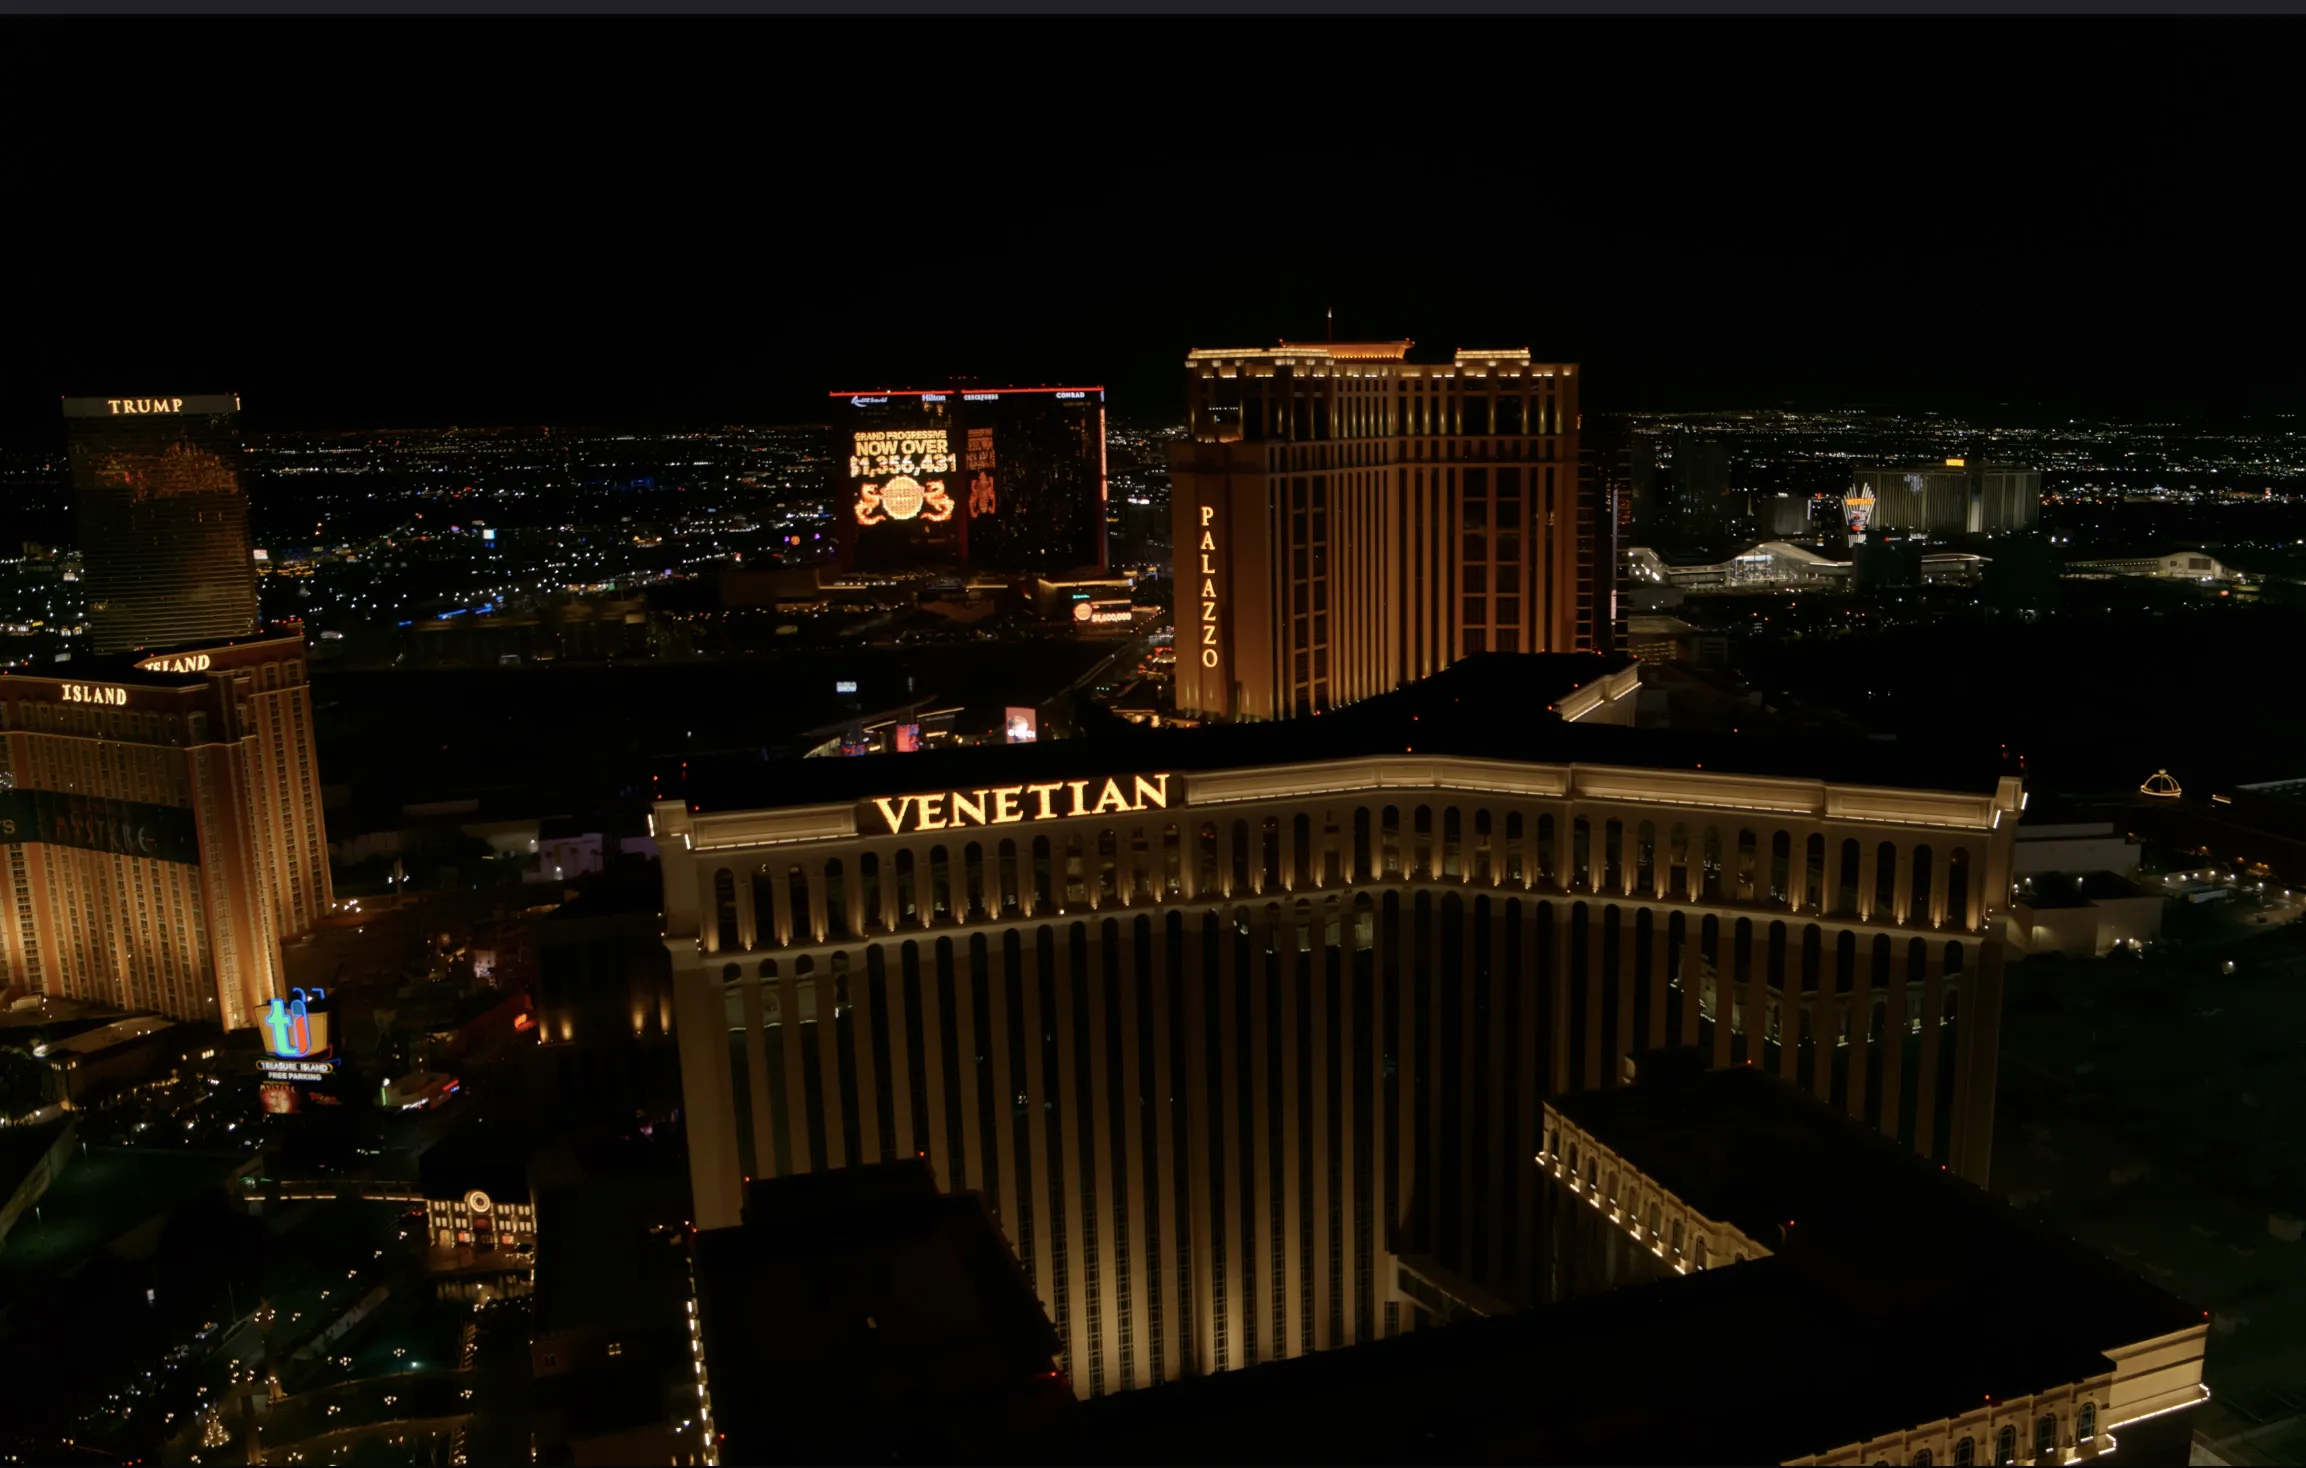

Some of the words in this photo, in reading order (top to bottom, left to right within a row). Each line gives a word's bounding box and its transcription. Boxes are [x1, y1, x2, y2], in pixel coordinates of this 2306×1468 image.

[108, 398, 183, 414] TRUMP
[922, 394, 946, 402] Hilton
[854, 432, 886, 441] GRAND
[886, 430, 947, 440] PROGRESSIVE
[856, 441, 898, 457] NOW
[901, 440, 948, 455] OVER
[850, 453, 956, 478] $1,356,431
[1200, 506, 1218, 668] PALAZZO
[61, 683, 127, 706] ISLAND
[1007, 728, 1036, 739] GCI
[872, 773, 1170, 835] VENETIAN
[260, 1062, 298, 1071] TREASURE
[300, 1063, 328, 1072] ISLAND
[268, 1071, 288, 1080] FREE
[288, 1072, 322, 1081] PARKING
